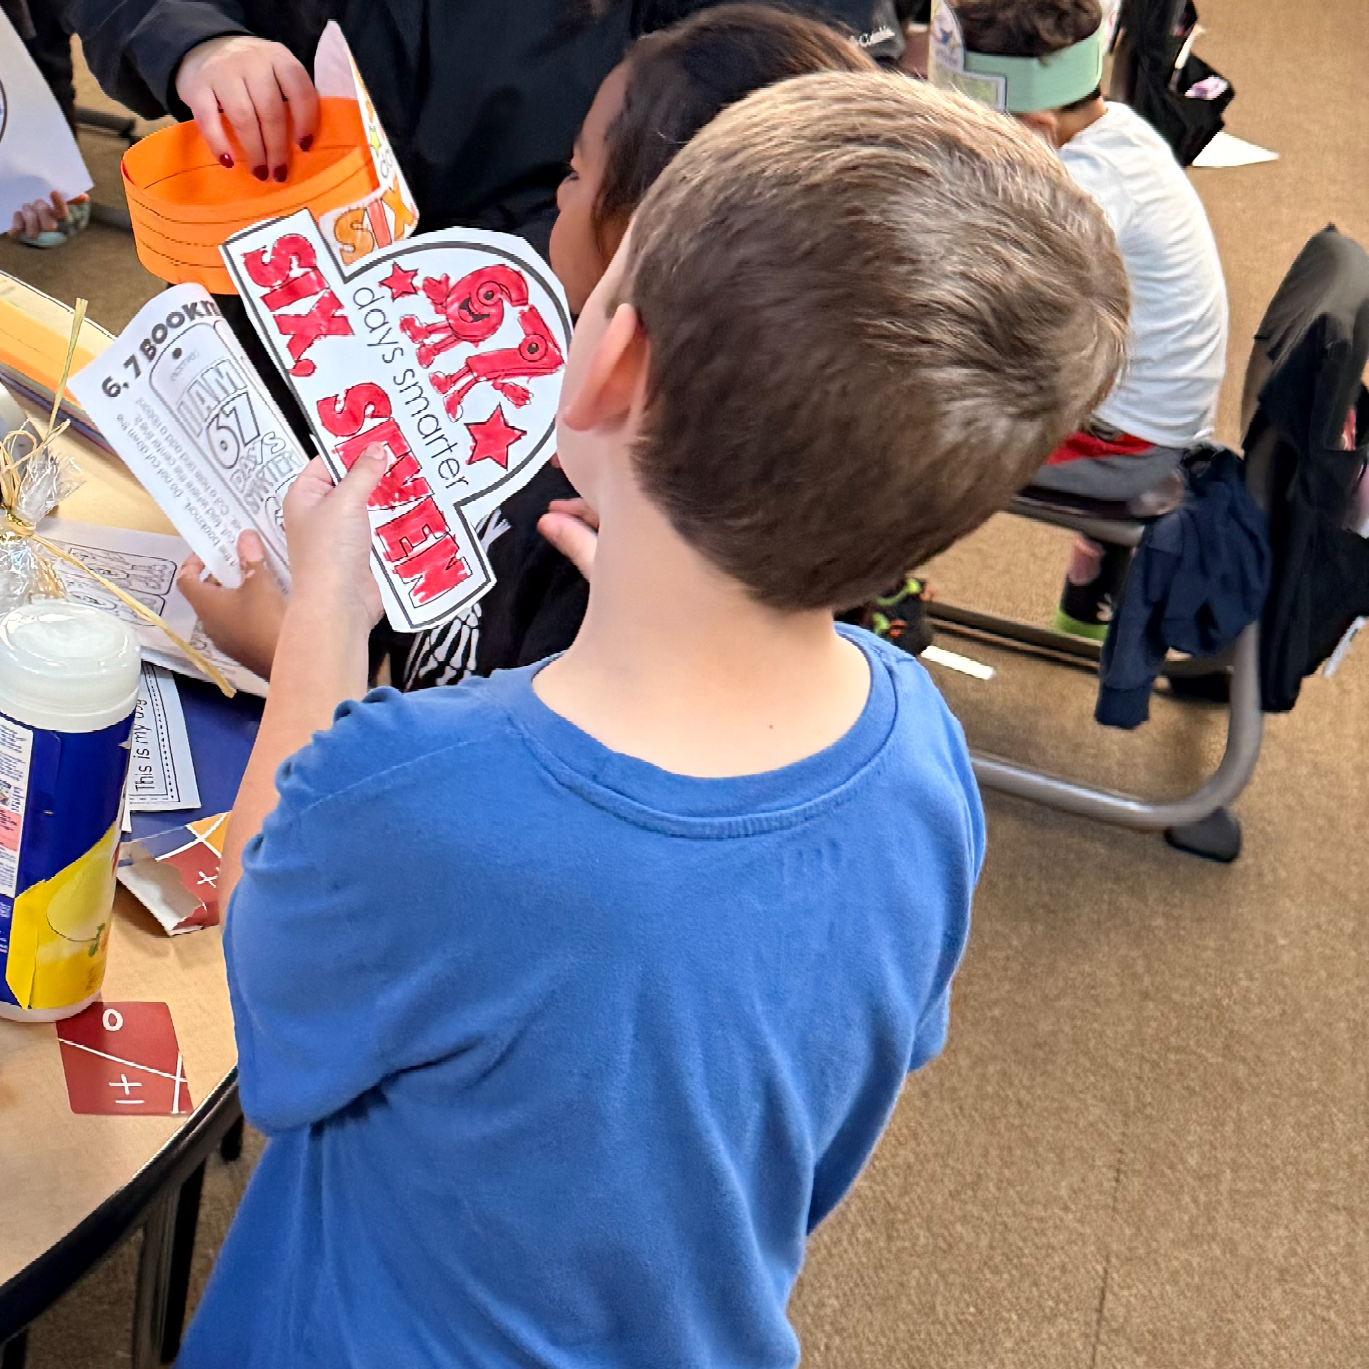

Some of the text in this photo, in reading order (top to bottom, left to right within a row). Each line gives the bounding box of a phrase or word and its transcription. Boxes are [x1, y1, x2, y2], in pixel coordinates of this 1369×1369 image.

[352, 286, 471, 490] days smarter
[316, 382, 472, 608] SEVEN
[134, 722, 152, 744] my
[133, 748, 150, 760] is
[134, 765, 155, 792] This
